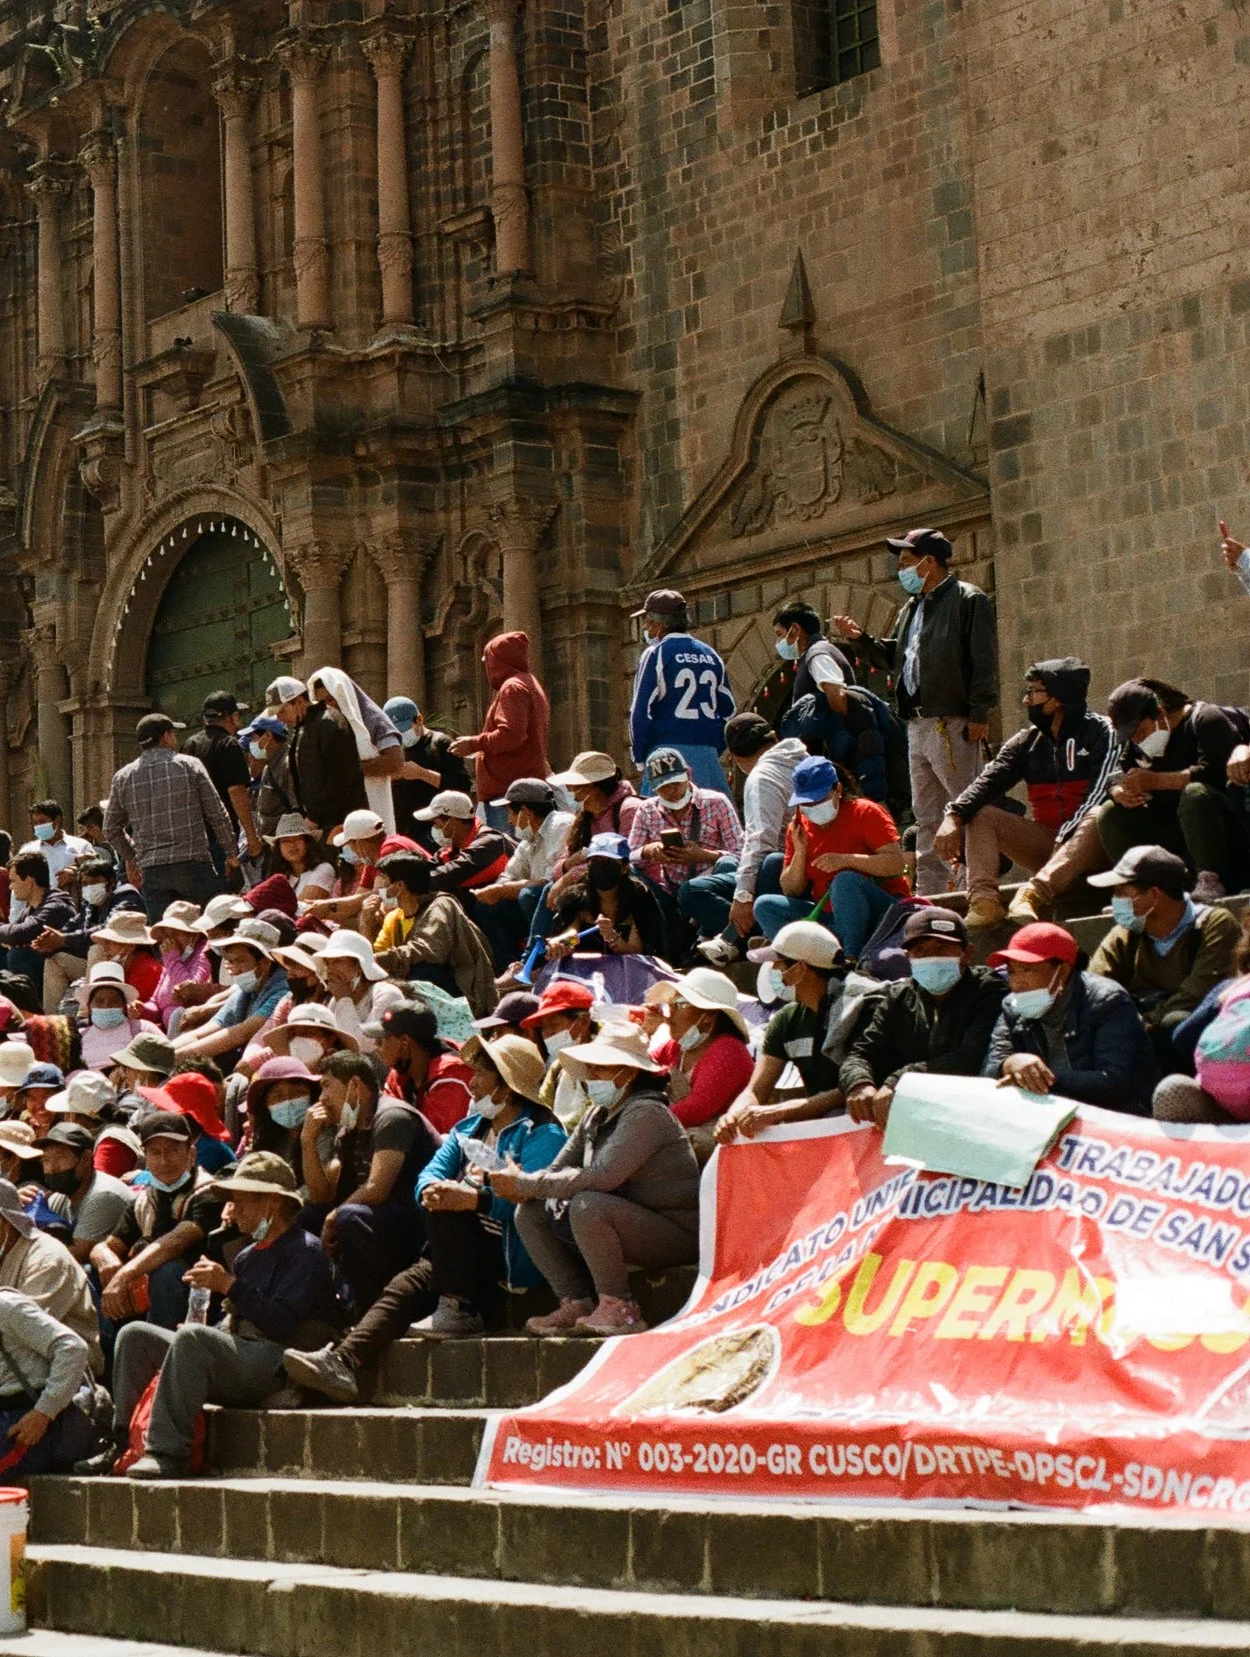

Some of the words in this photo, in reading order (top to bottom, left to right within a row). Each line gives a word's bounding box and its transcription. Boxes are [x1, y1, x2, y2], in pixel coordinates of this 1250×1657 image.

[675, 653, 716, 666] CESAR
[674, 668, 718, 719] 23
[650, 757, 676, 777] NY
[1106, 1198, 1161, 1233] DE
[1159, 1215, 1236, 1262] SAN
[701, 1216, 846, 1321] NDICATO
[502, 1436, 600, 1471] Registro:
[637, 1443, 802, 1475] 003-2020-GR
